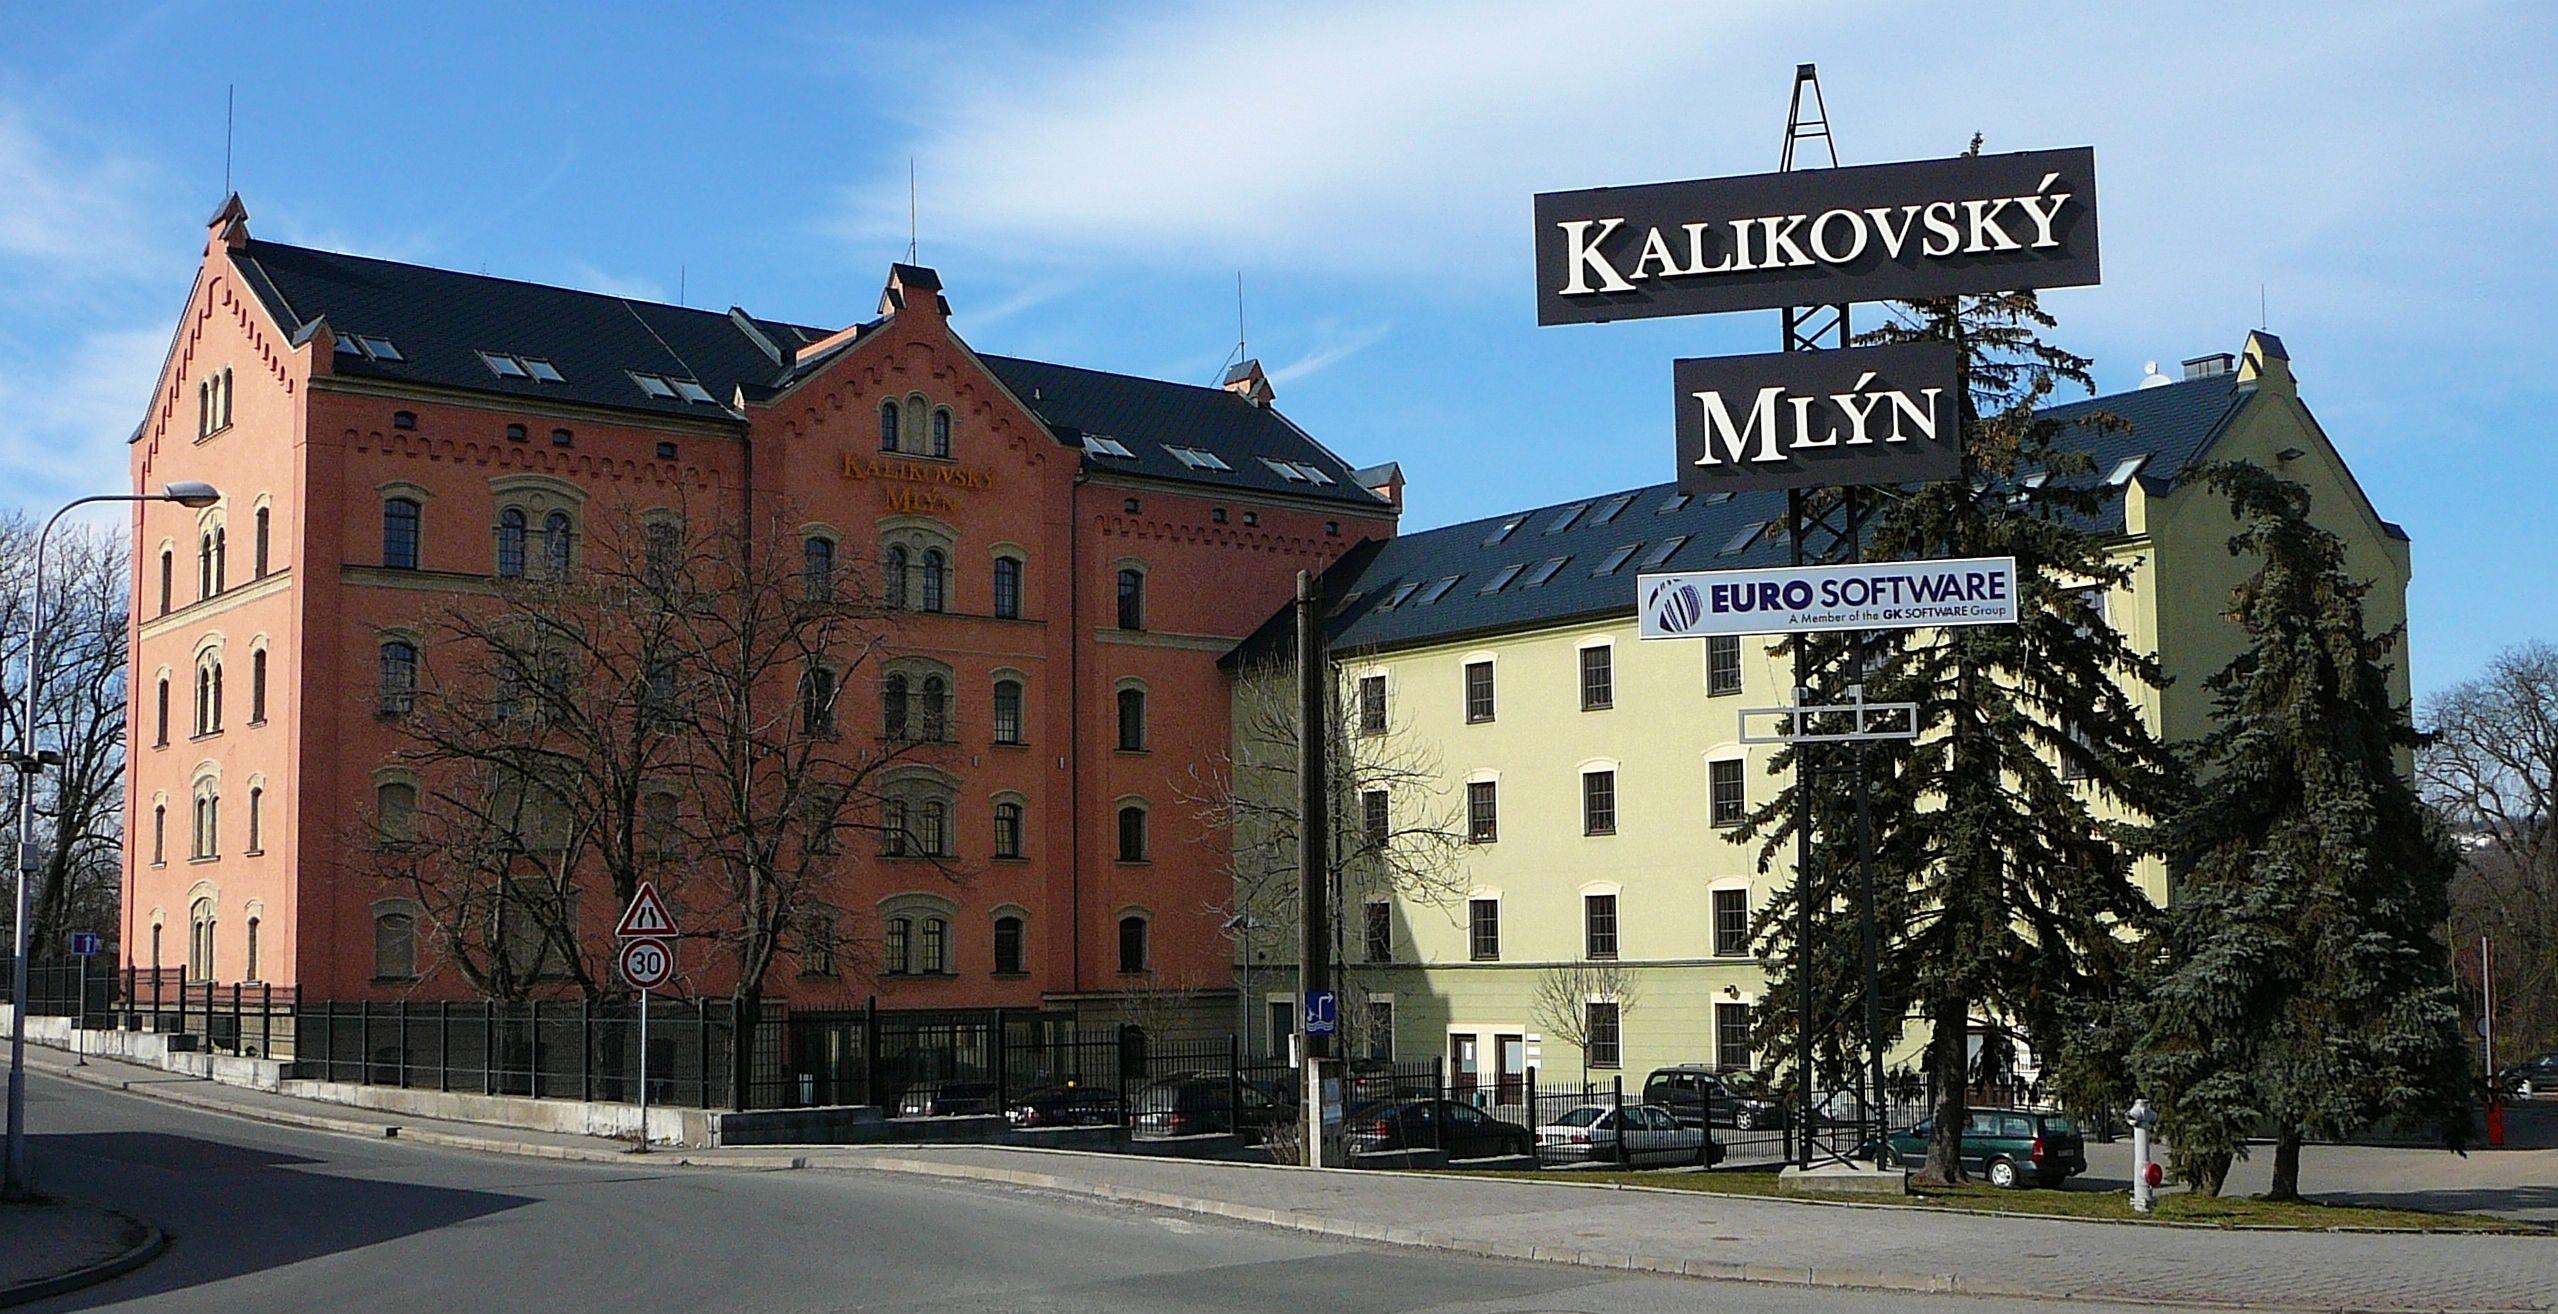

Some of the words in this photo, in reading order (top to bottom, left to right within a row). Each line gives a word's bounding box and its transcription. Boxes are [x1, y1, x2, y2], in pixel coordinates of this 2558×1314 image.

[1556, 172, 2072, 296] KALIKOVSKÝ
[1692, 372, 1944, 466] MLÝN
[1711, 580, 1814, 613] EURO
[1820, 571, 2006, 608] SOFTWARE
[1788, 613, 1799, 625] A
[1801, 612, 1846, 624] Member
[1848, 610, 1860, 622] of
[1862, 609, 1879, 621] the
[1883, 608, 1903, 620] GK
[1904, 605, 1968, 619] SOFTWARE
[1970, 605, 2007, 618] Group
[631, 951, 662, 975] 30
